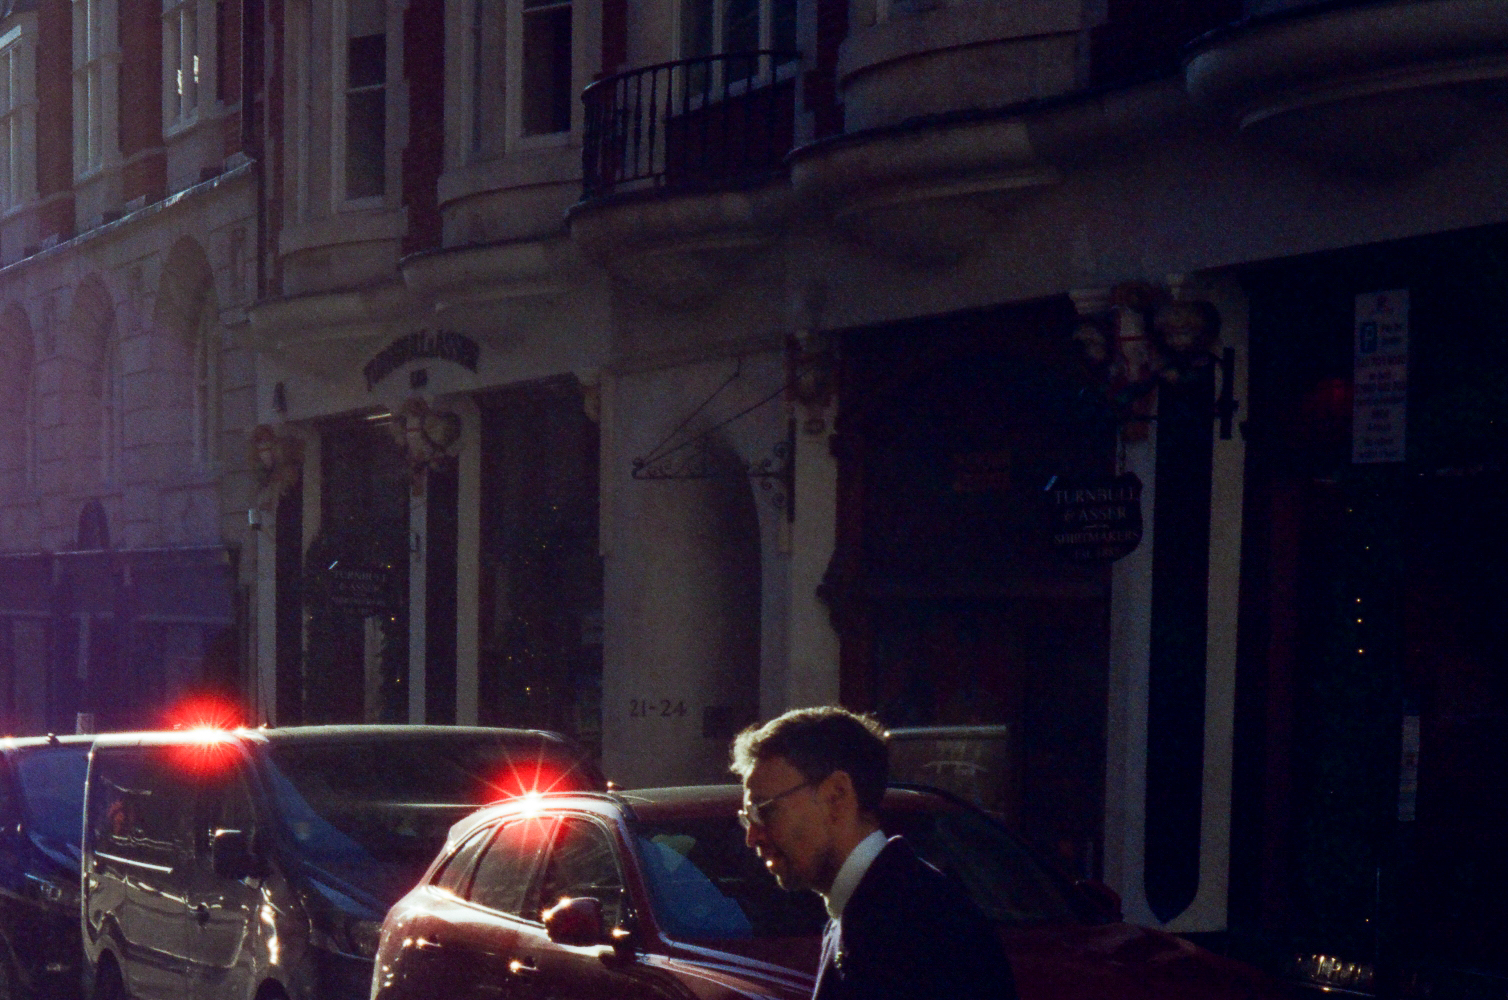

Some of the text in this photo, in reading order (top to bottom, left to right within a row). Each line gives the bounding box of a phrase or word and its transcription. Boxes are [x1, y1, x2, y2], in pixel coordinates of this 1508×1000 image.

[1054, 486, 1140, 504] TURNBULL
[1078, 506, 1127, 521] ASSER
[630, 699, 687, 717] 21-24
